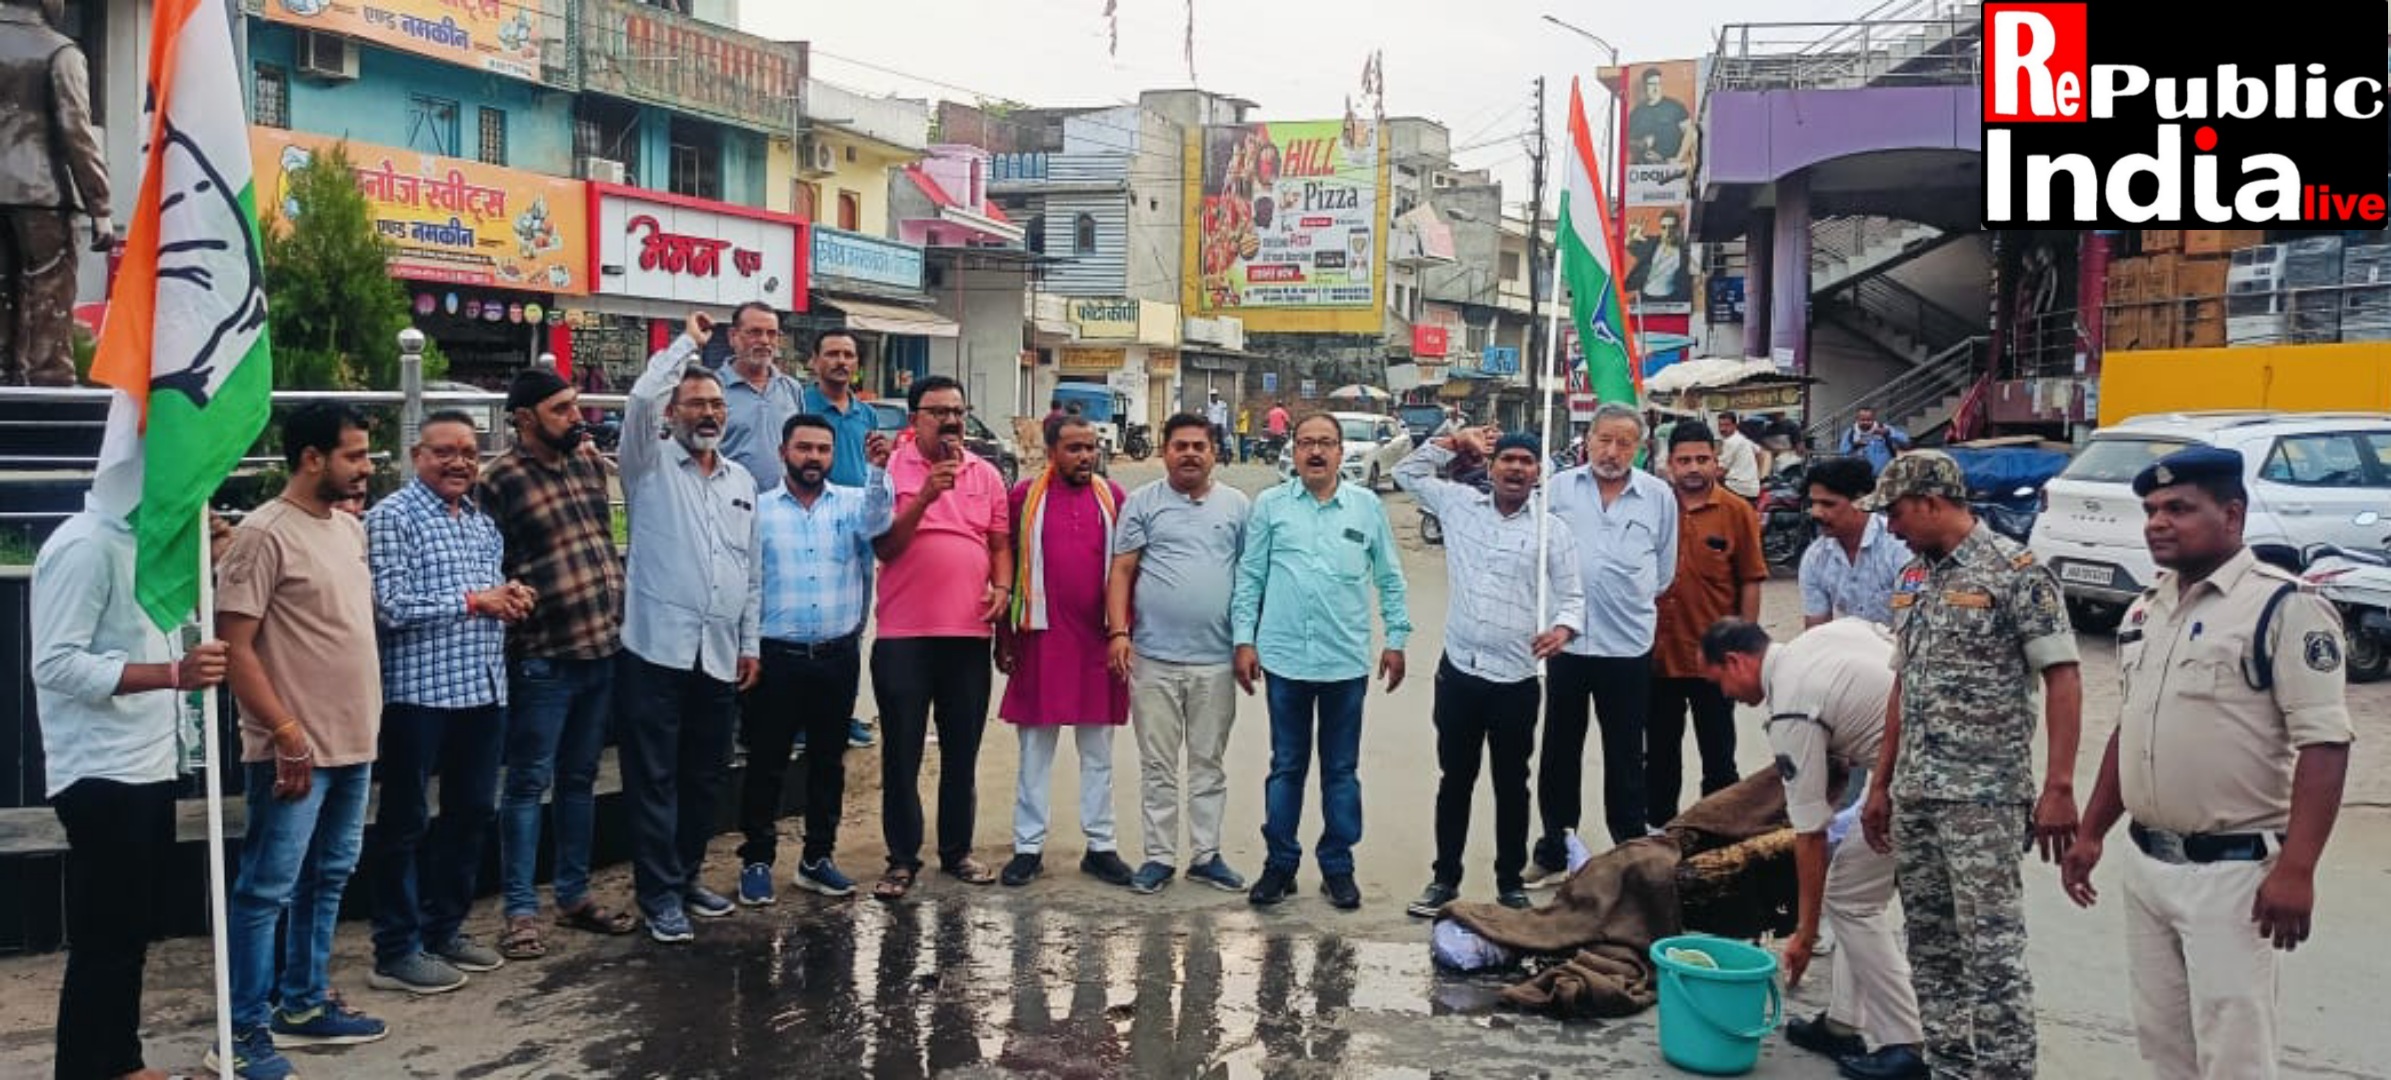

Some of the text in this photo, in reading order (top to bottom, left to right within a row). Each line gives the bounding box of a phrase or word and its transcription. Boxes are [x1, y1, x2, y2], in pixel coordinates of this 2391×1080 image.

[401, 13, 470, 50] नमकीन
[424, 169, 506, 223] स्वीट्स
[1304, 181, 1358, 211] Pizza
[411, 216, 475, 248] नमकीन
